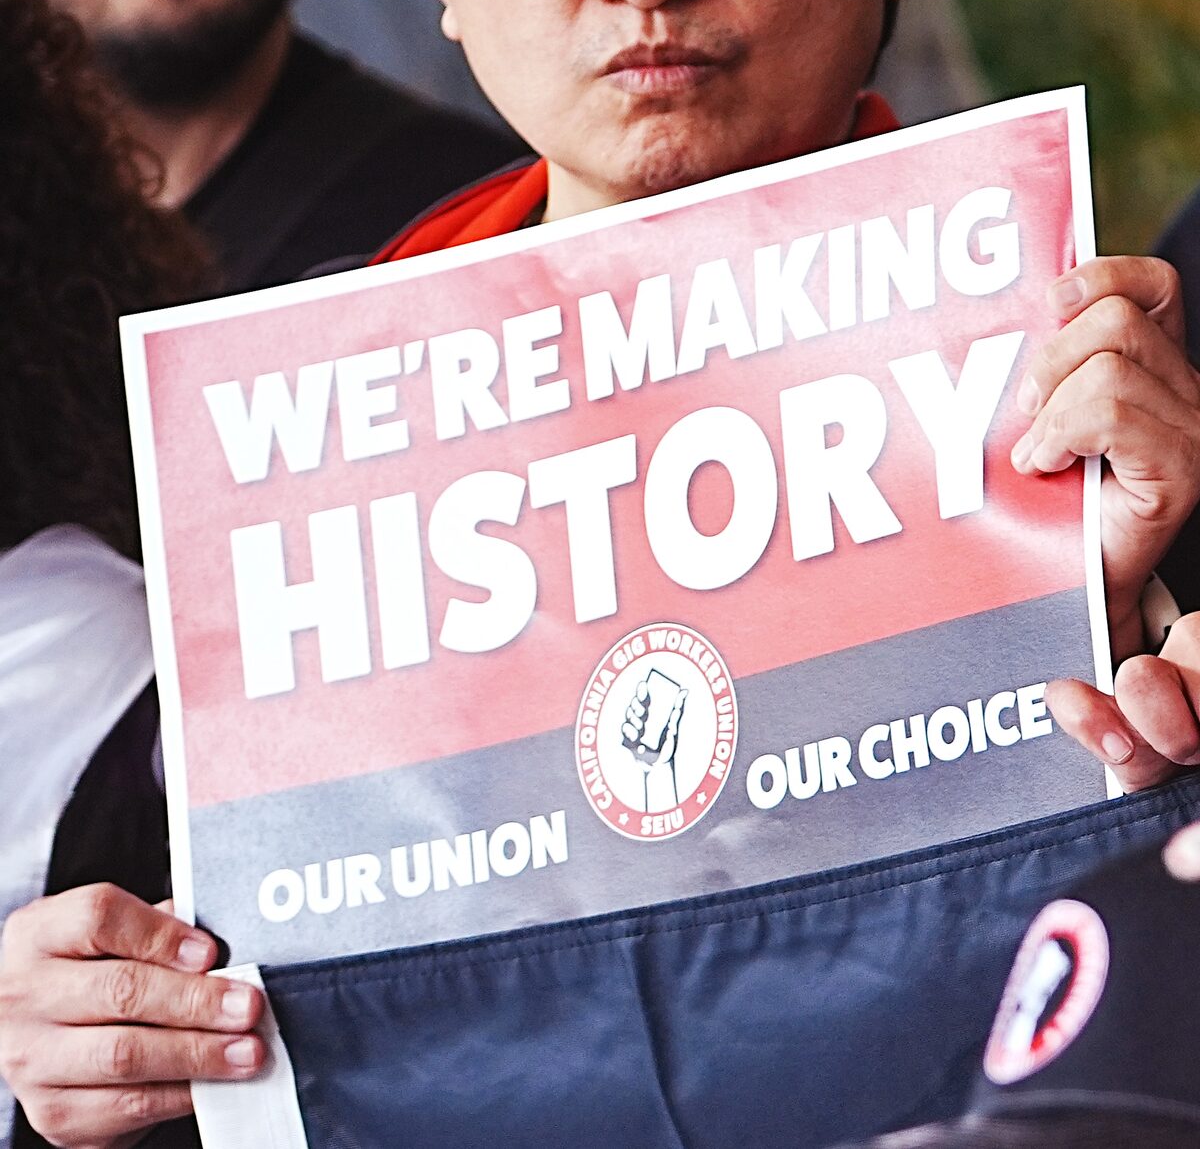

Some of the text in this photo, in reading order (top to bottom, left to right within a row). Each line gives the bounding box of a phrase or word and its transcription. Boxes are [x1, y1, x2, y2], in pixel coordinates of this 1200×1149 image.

[202, 185, 1022, 484] WE'RE MAKING
[228, 328, 1027, 700] HISTORY
[579, 629, 734, 811] CALIFORNIA GIG WORKERS UNION
[745, 681, 1054, 812] OUR CHOICE
[256, 809, 570, 924] OUR UNION
[640, 807, 685, 836] SEIU
